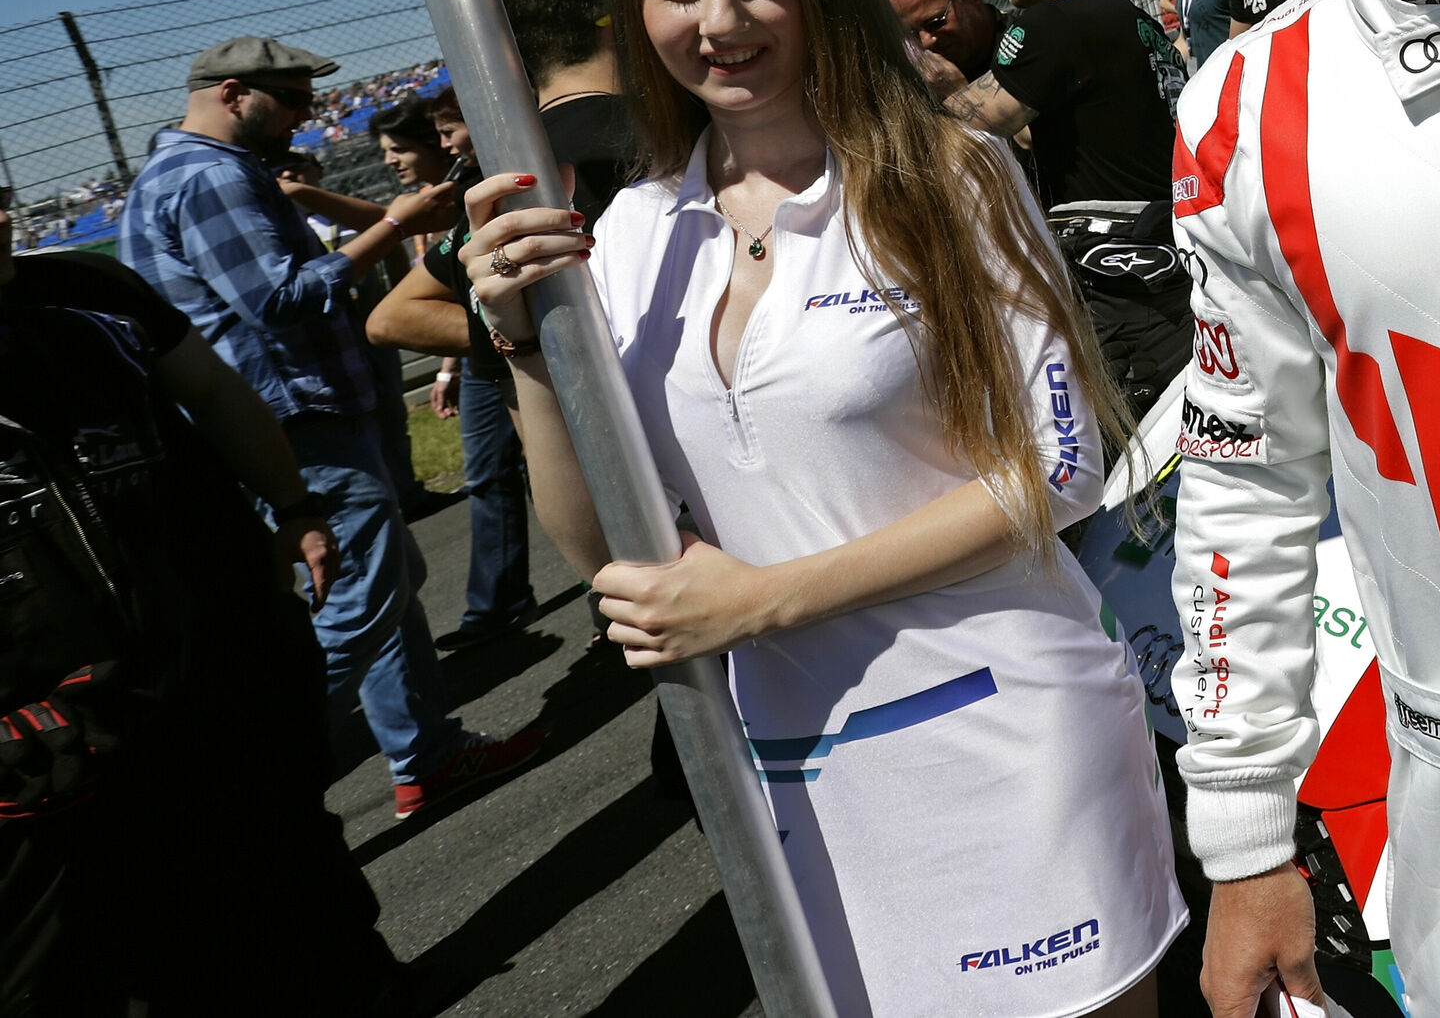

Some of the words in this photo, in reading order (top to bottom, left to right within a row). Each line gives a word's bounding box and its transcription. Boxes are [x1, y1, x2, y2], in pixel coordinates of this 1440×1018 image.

[804, 287, 913, 311] FALKE
[849, 306, 866, 314] ON
[868, 304, 888, 313] THE
[1209, 587, 1231, 648] Audi
[957, 918, 1100, 972] FALKEN
[1015, 965, 1033, 976] ON
[1035, 956, 1058, 972] THE
[1061, 939, 1101, 967] PULSE
